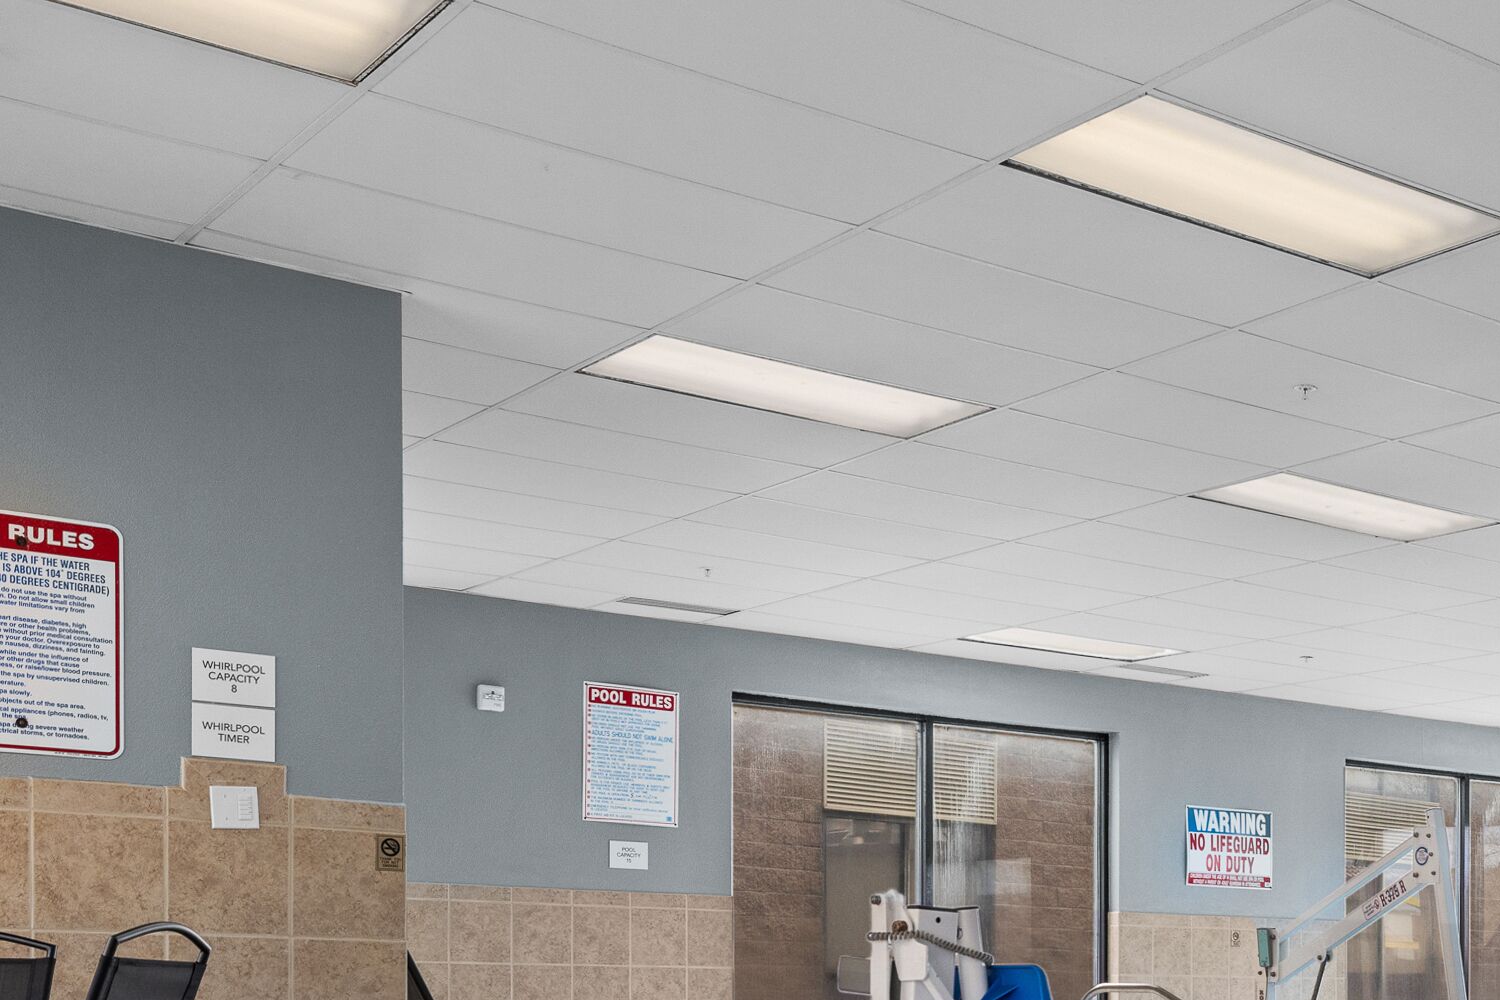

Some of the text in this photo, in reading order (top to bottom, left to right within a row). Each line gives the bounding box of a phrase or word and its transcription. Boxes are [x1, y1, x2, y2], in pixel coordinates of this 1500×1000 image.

[8, 524, 94, 550] RULES
[11, 554, 28, 563] SPA
[31, 556, 38, 564] IF
[41, 557, 57, 567] THE
[60, 560, 90, 571] WATER
[3, 564, 11, 572] IS
[14, 565, 42, 576] ABOVE
[67, 572, 105, 583] DEGREES
[10, 575, 50, 588] DEGREES
[52, 580, 109, 596] CENTIGRADE)
[19, 601, 53, 610] limitations
[47, 638, 92, 648] Overexposure
[73, 635, 112, 644] consultation
[33, 643, 64, 652] dizziness,
[80, 648, 105, 656] fainting.
[25, 664, 60, 672] raise/lower
[202, 660, 265, 674] WHIRLPOOL
[37, 674, 80, 682] unsupervised
[82, 678, 109, 686] children.
[209, 672, 260, 684] CAPACITY
[231, 684, 237, 693] 8
[591, 688, 672, 709] POOL RULES
[21, 728, 45, 736] storms,
[202, 721, 265, 735] WHIRLPOOL
[218, 733, 250, 744] TIMER
[1193, 809, 1266, 836] WARNING
[1190, 833, 1269, 855] NO LIFEGUARD
[1206, 854, 1254, 873] ON DUTY
